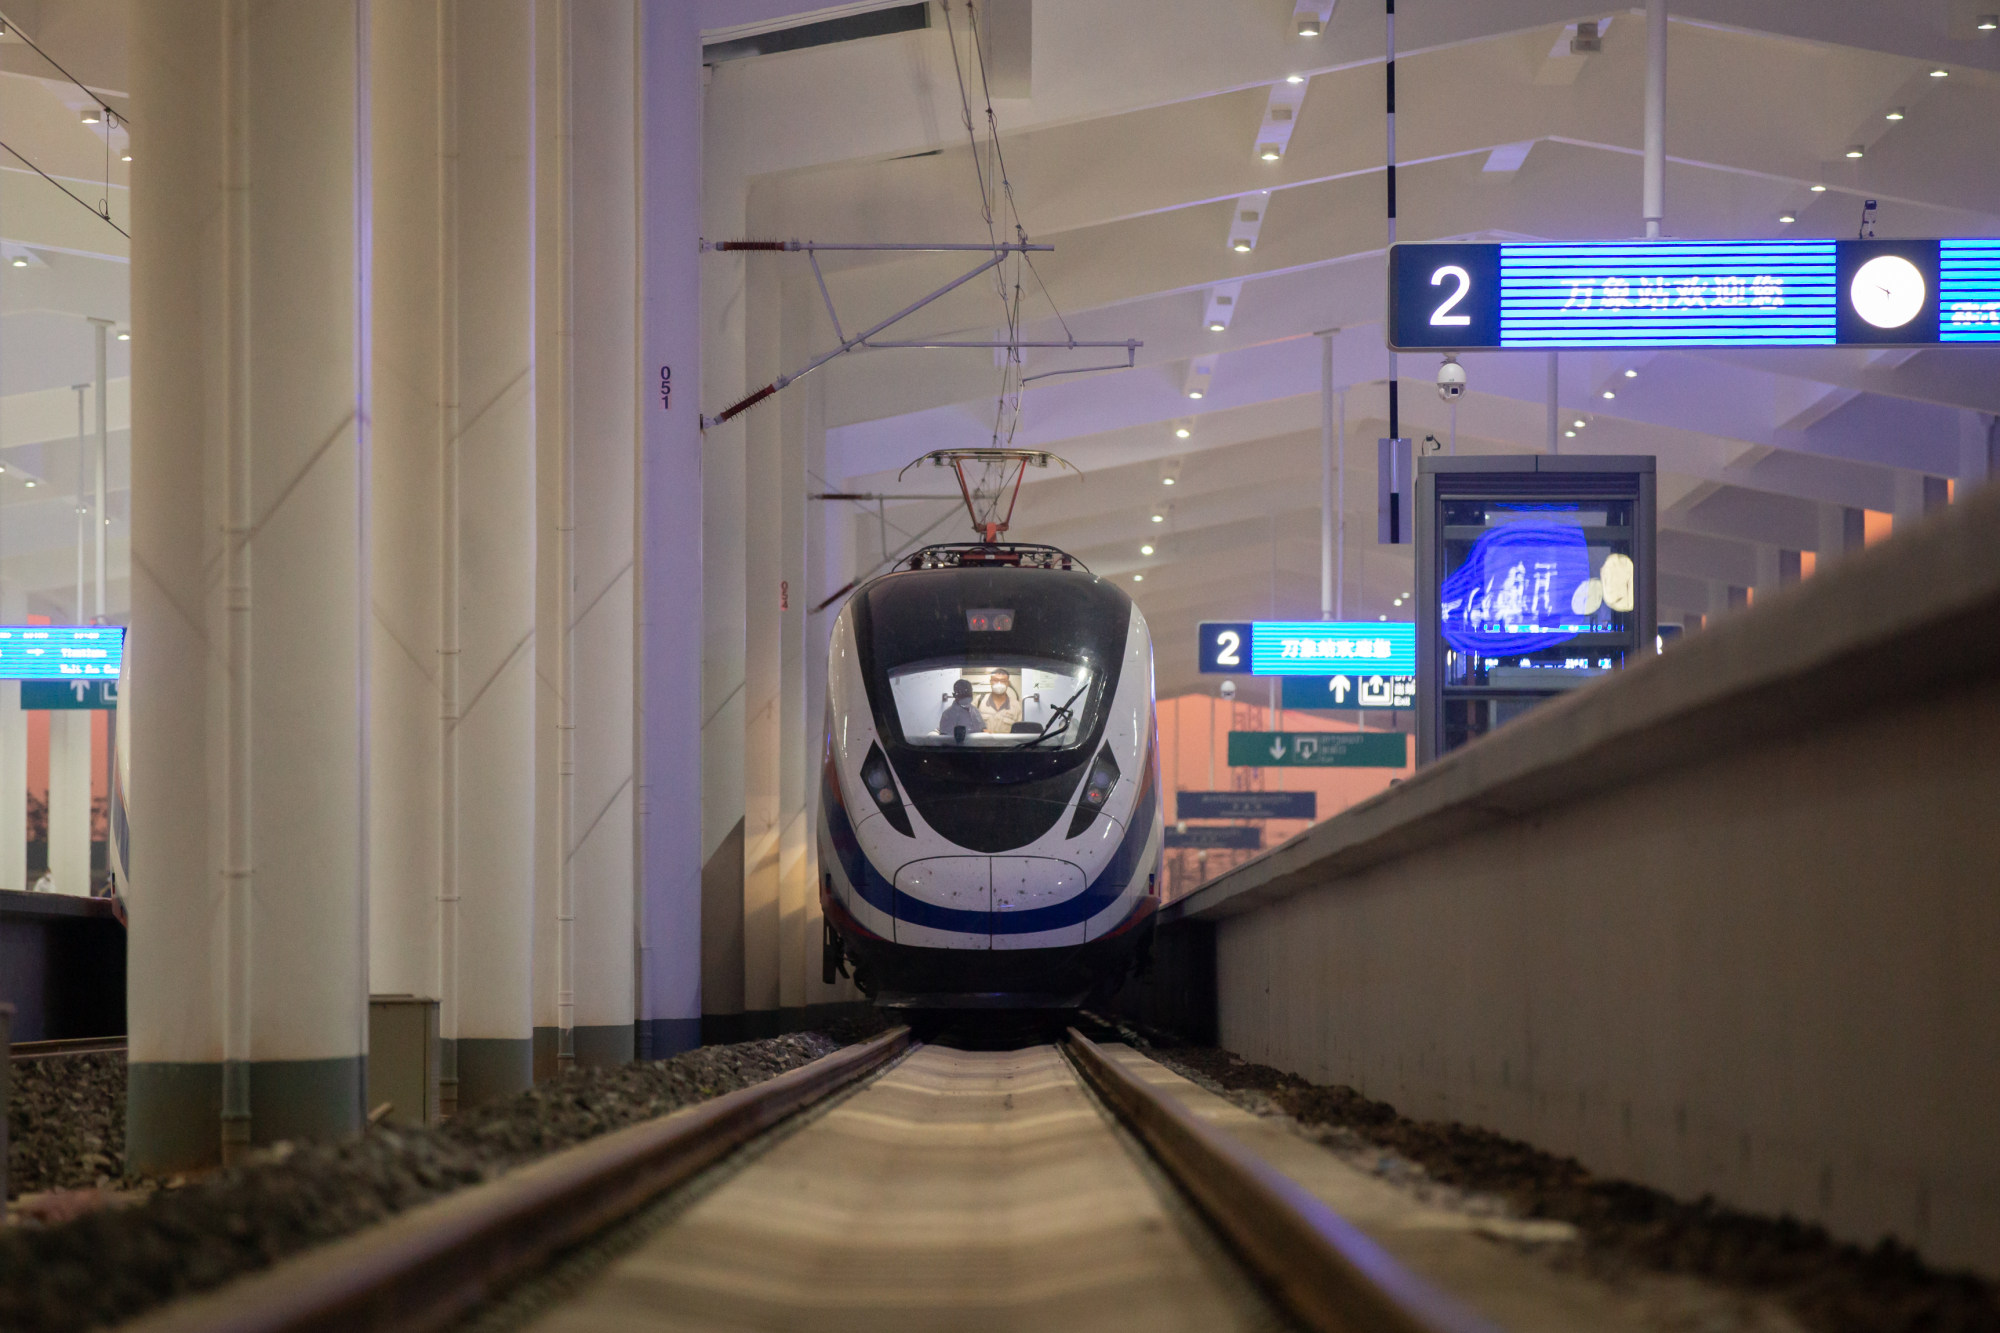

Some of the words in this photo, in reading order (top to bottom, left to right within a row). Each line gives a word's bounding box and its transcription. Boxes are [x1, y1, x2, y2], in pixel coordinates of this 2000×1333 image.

[1429, 265, 1471, 326] 2
[1560, 275, 1785, 311] 万象站欢迎您
[661, 366, 671, 409] 051
[1216, 631, 1240, 665] 2
